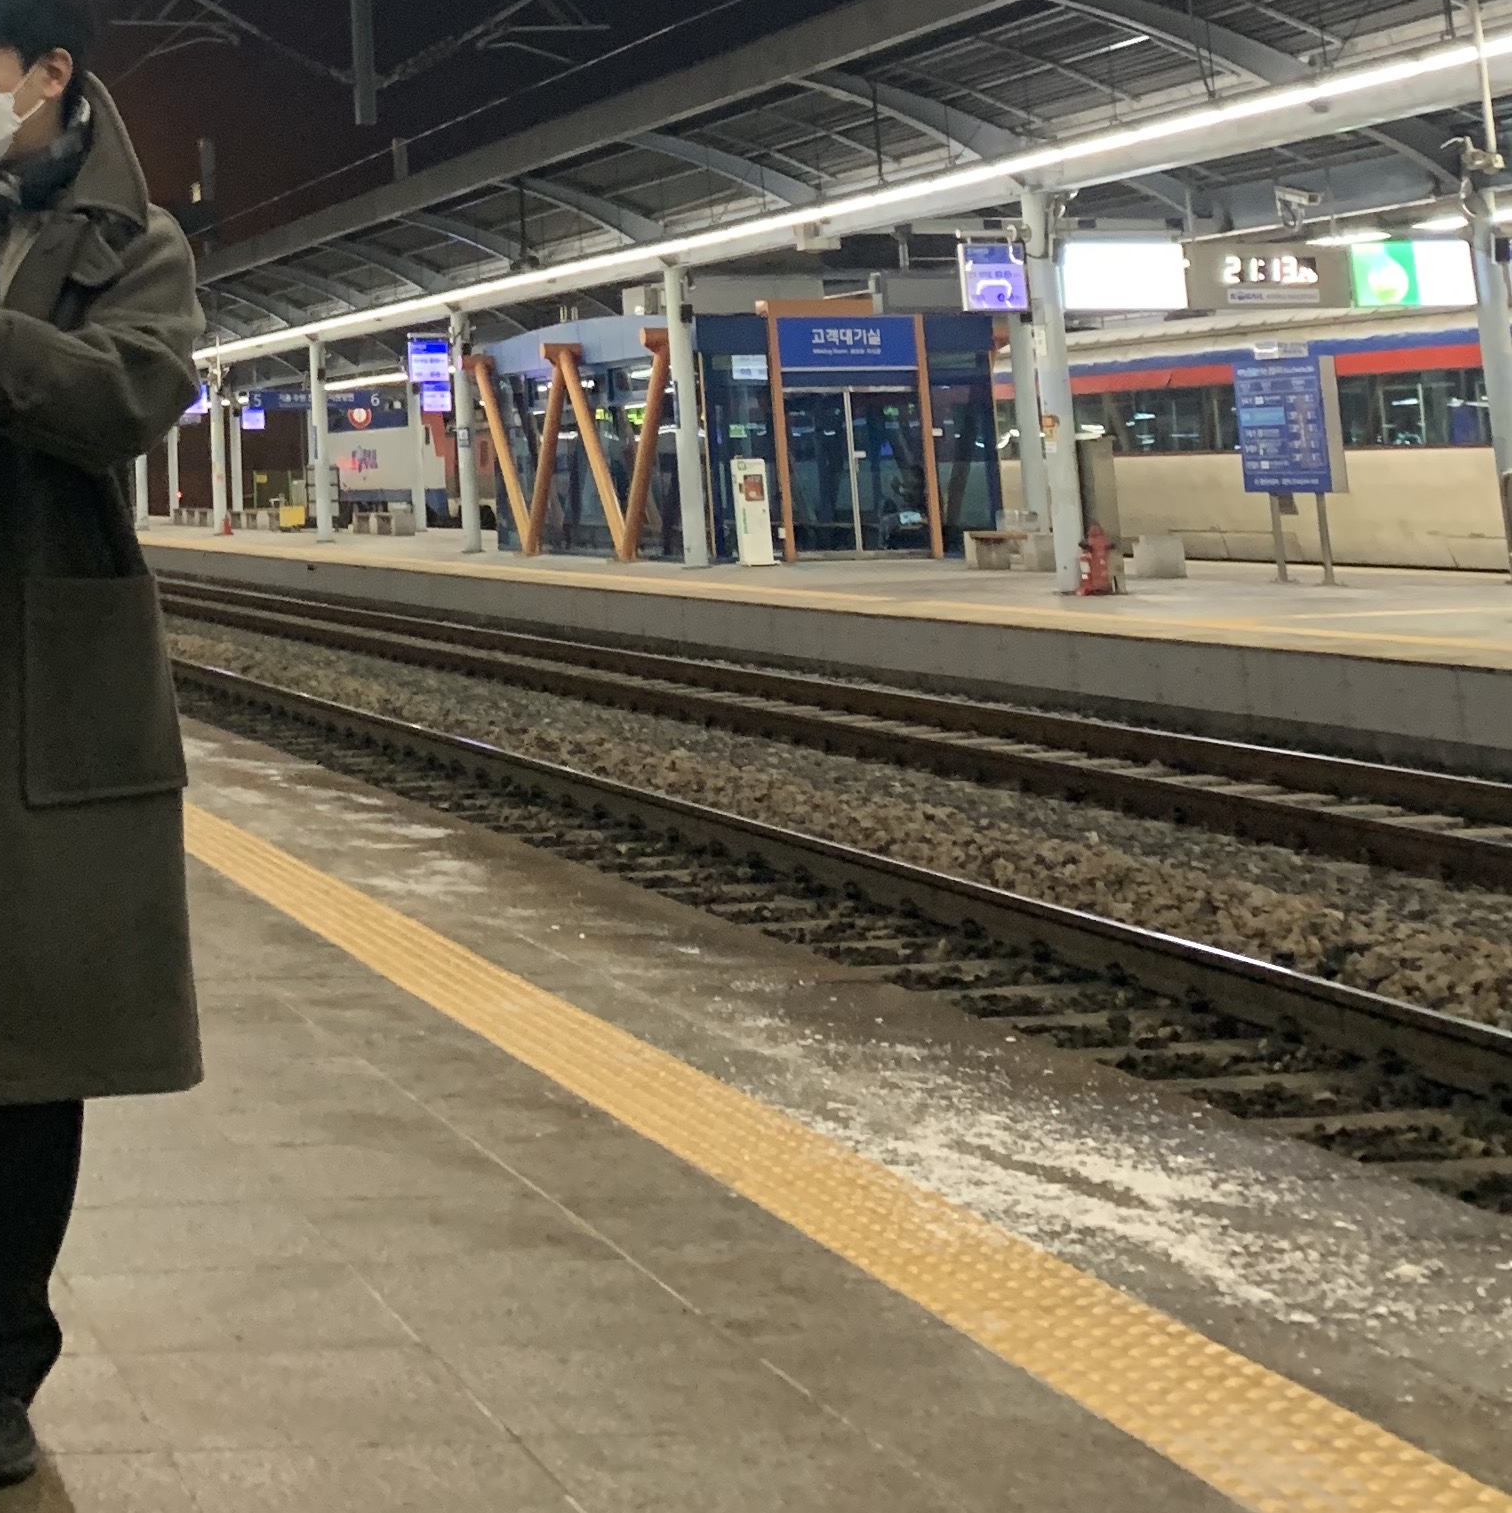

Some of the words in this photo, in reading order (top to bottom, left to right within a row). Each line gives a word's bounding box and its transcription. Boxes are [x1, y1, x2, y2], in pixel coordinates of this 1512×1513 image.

[811, 328, 881, 346] 고객대기실
[253, 393, 262, 408] 5
[370, 393, 381, 407] 6
